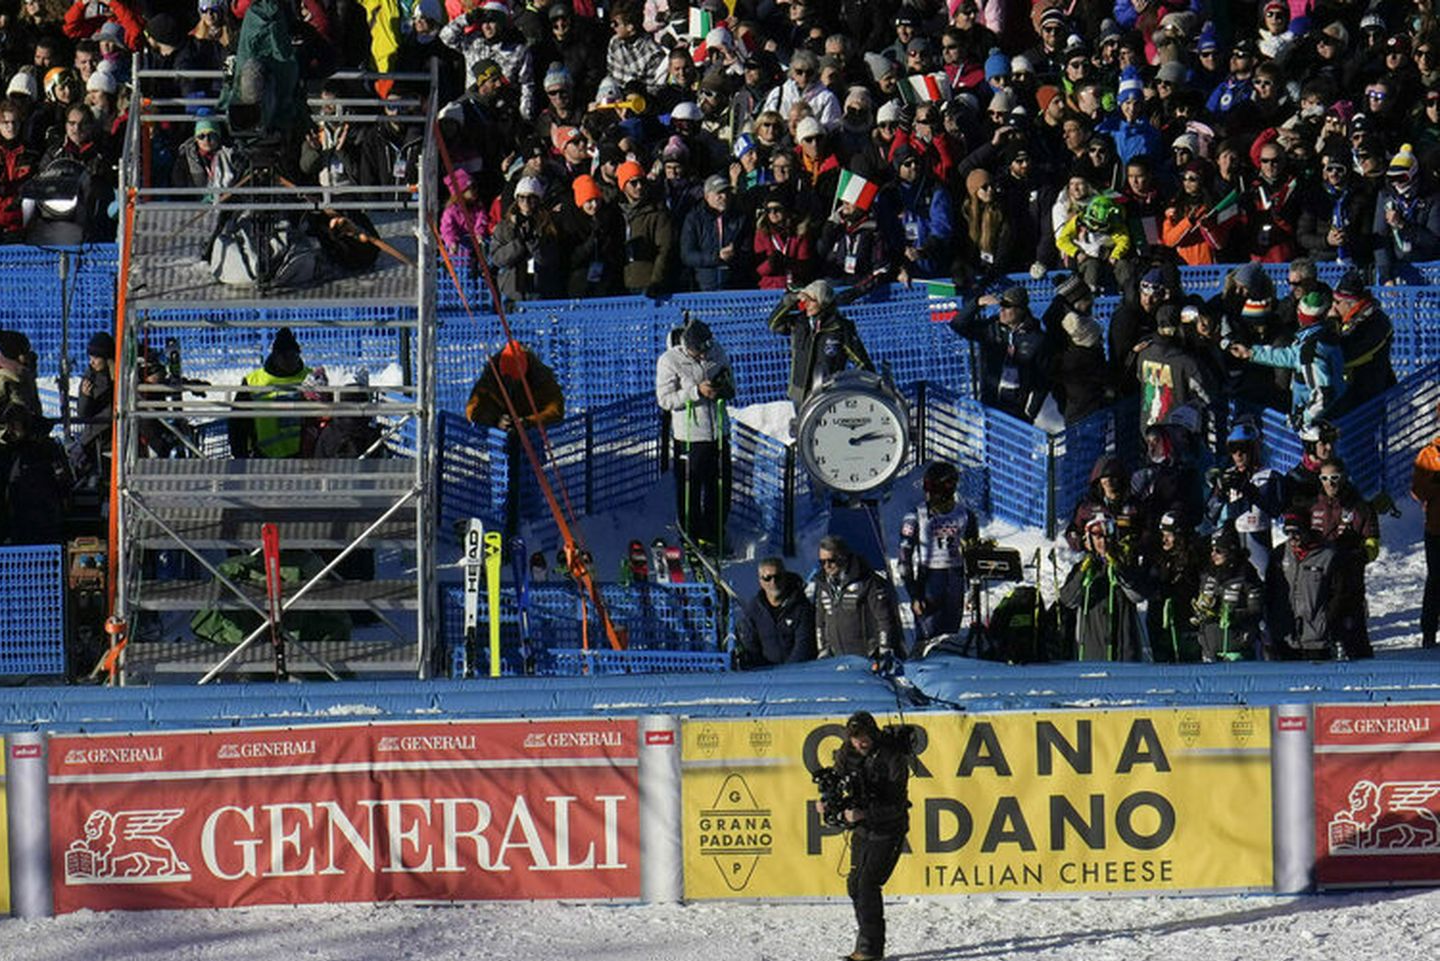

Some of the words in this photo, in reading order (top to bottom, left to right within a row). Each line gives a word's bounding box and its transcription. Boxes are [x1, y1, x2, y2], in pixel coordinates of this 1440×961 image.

[1354, 717, 1430, 733] GENERALI
[400, 735, 476, 750] GENERALI
[547, 732, 622, 748] GENERALI
[88, 747, 163, 764] GENERALI
[241, 740, 316, 757] GENERALI
[729, 790, 741, 803] G
[700, 818, 772, 831] GRANA
[806, 791, 1177, 855] PDANO
[200, 795, 627, 880] GENERALI
[700, 833, 773, 847] PADANO
[733, 862, 742, 875] P
[925, 863, 1043, 887] ITALIAN
[1059, 860, 1173, 884] CHEESE
